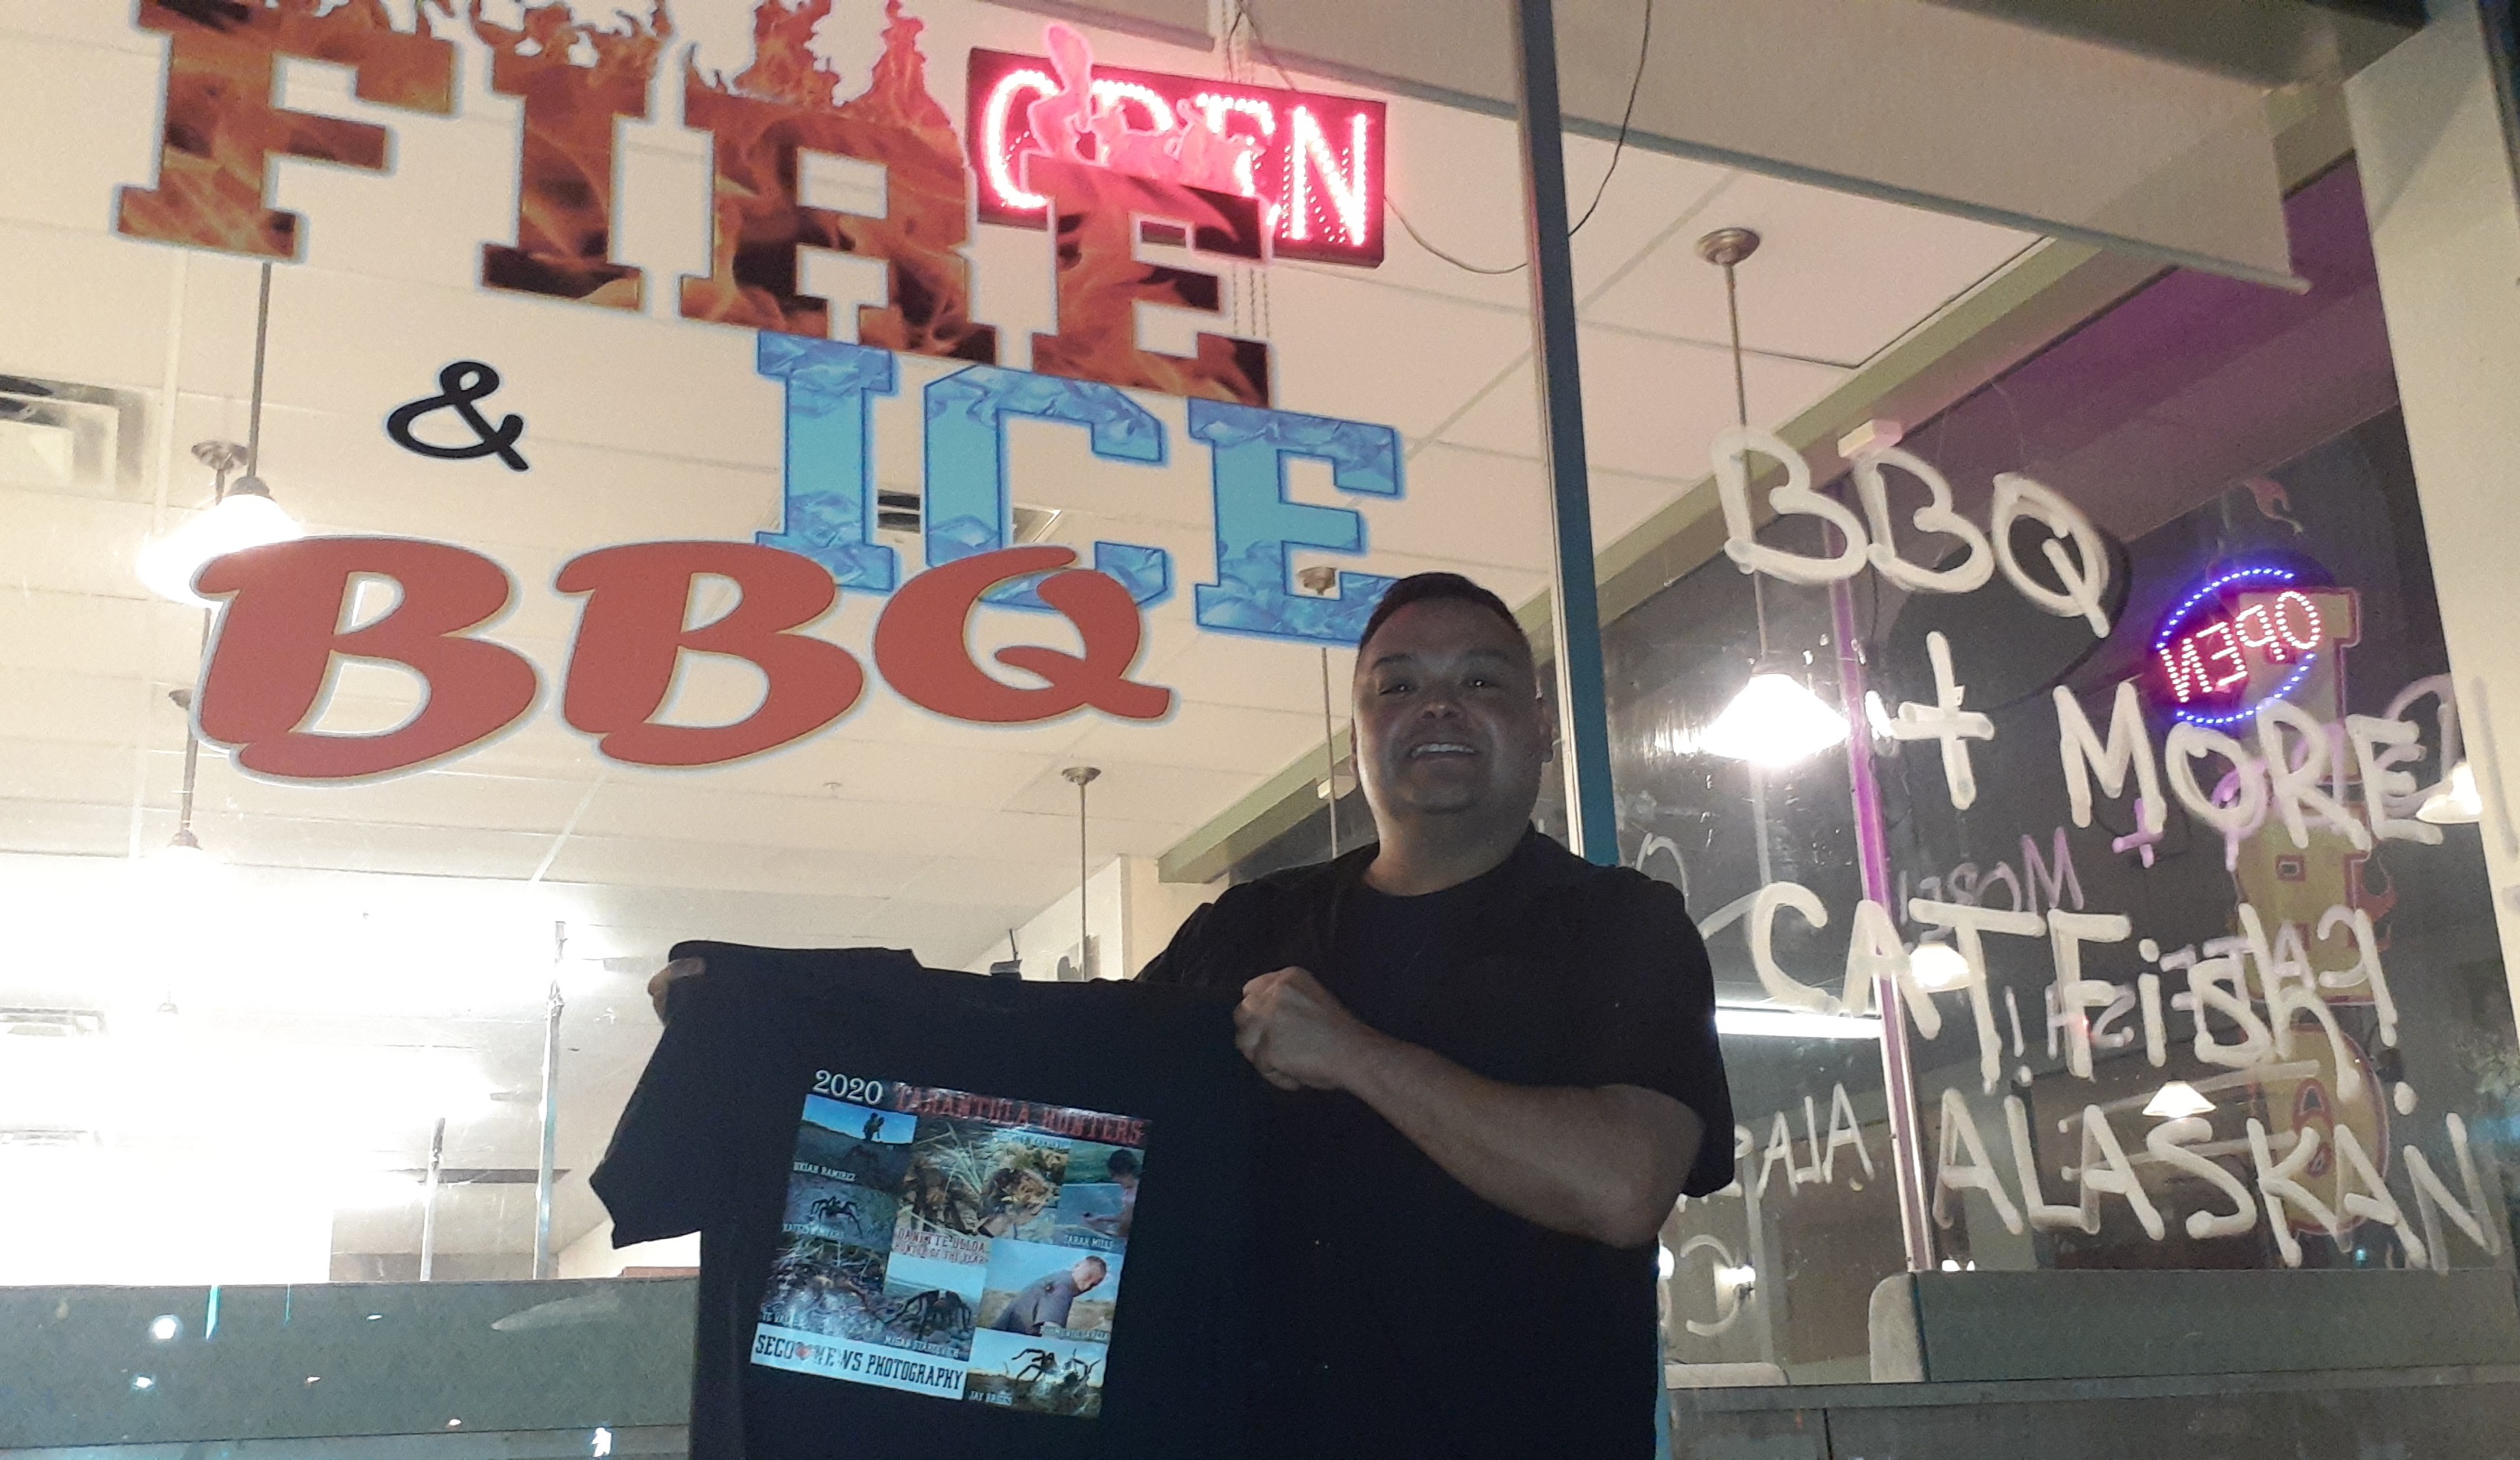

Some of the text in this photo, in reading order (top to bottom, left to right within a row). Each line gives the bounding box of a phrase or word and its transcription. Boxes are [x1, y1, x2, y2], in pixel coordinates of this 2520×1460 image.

[119, 0, 1268, 408] FIRE
[386, 360, 529, 473] &
[757, 332, 1398, 643] ICE
[1711, 425, 2110, 638] BBQ
[193, 535, 1171, 779] BBQ
[811, 1070, 1146, 1146] 2020 TARANTULA HUNTERS
[1931, 1087, 2503, 1275] ALASKAN
[865, 1354, 964, 1390] PHOTOGRAPHY
